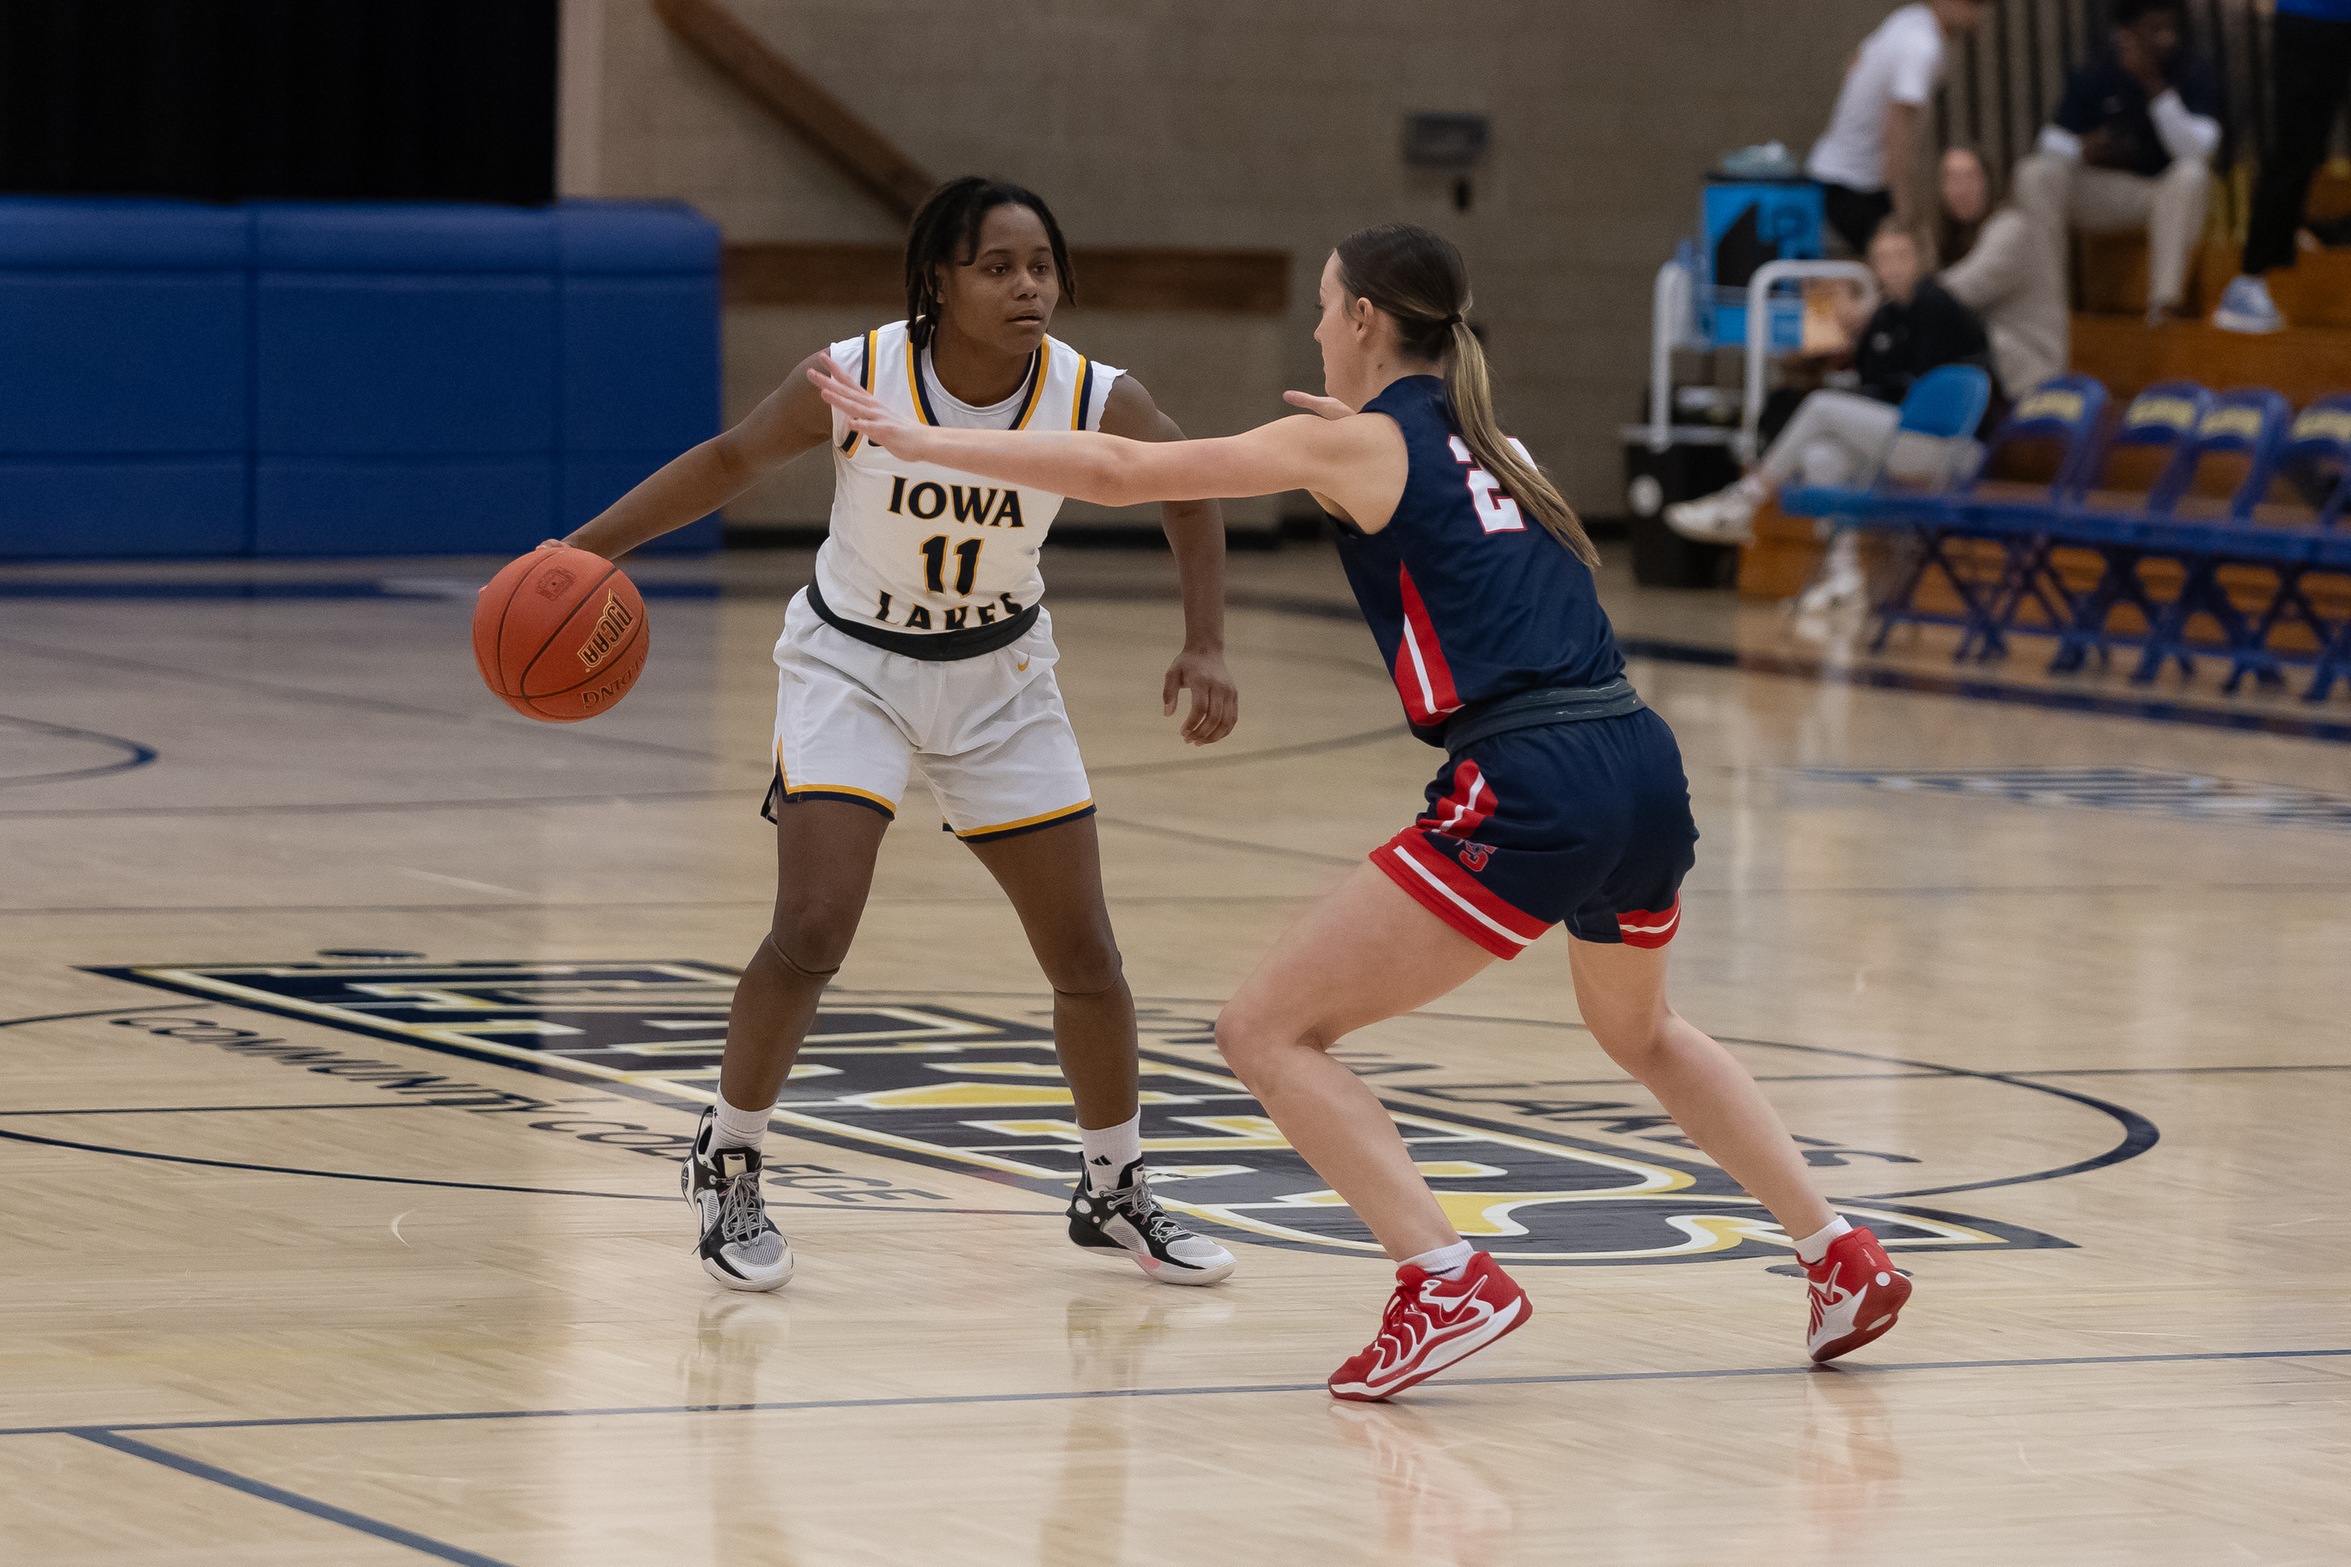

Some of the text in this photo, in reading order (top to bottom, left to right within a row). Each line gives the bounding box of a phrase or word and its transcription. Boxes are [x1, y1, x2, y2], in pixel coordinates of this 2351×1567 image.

[887, 475, 1025, 528] IOWA
[1447, 433, 1539, 535] 2
[919, 534, 985, 598] 11
[578, 588, 636, 667] NJCAA
[875, 589, 1024, 631] LAKES
[108, 1016, 590, 1114] COMMUNITY
